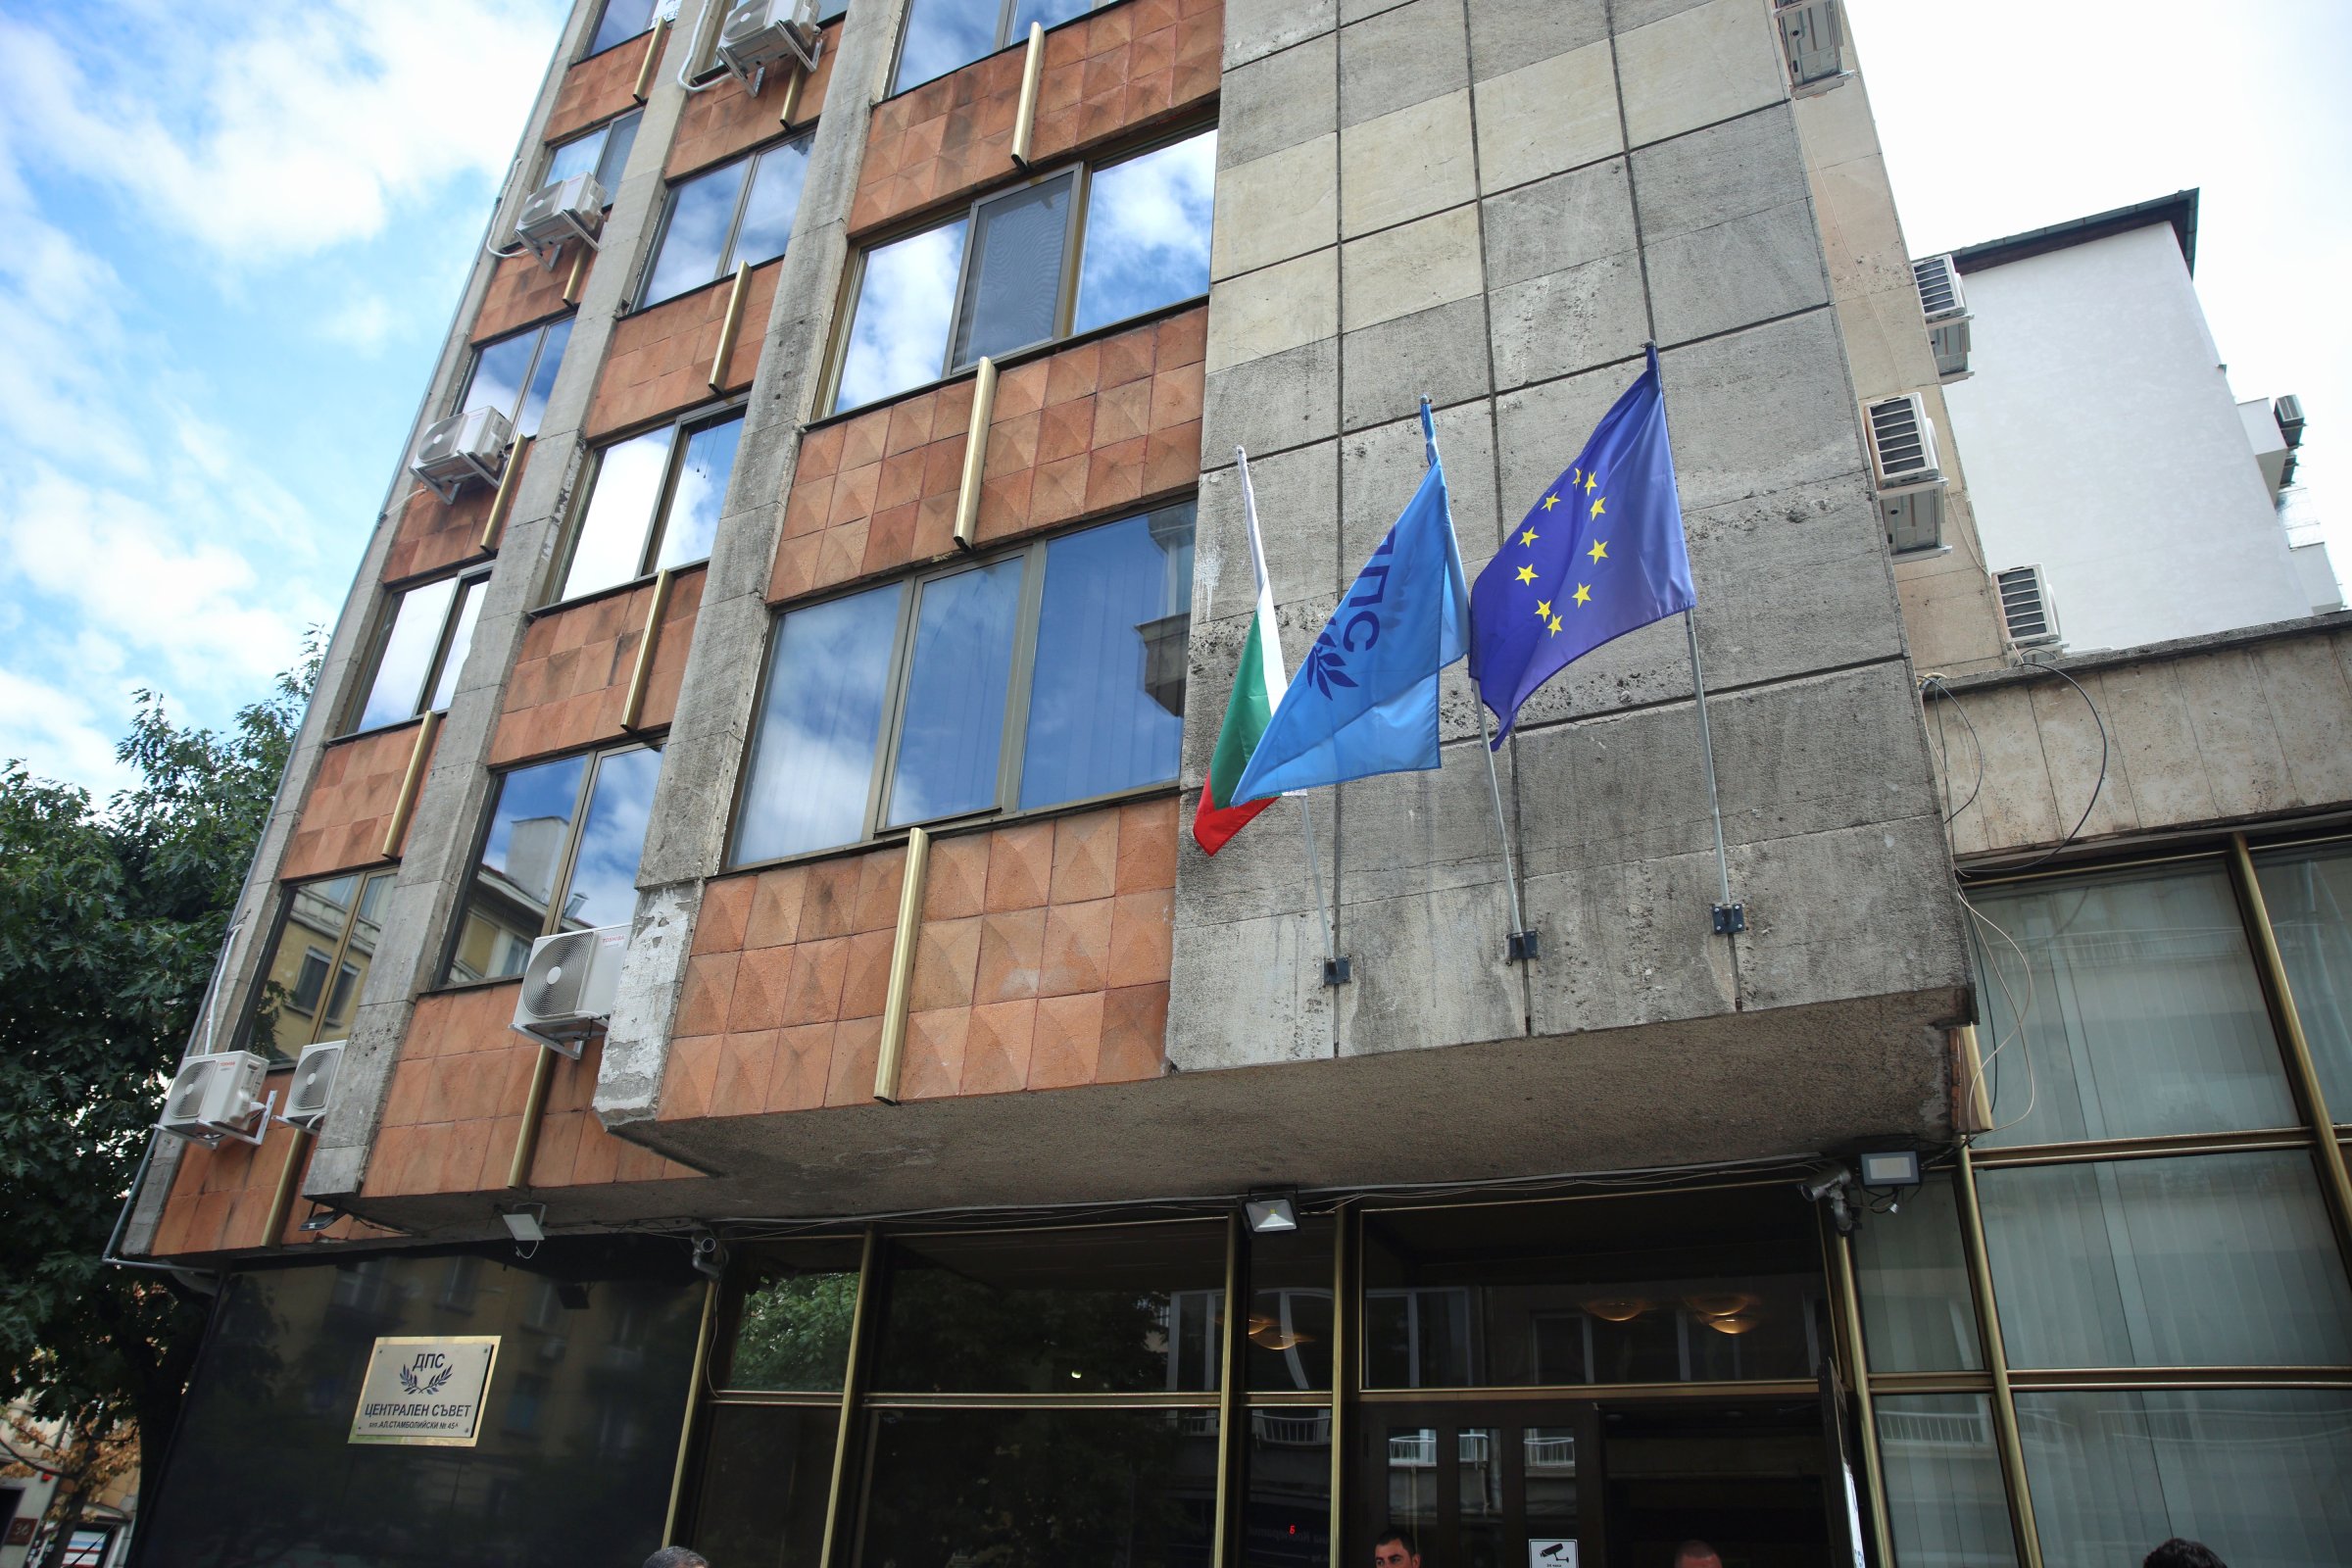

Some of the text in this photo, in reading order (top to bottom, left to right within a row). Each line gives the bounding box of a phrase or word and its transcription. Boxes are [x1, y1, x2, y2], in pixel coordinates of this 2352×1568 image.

[412, 1353, 446, 1372] ДПС
[365, 1403, 471, 1418] ЦЕНТРАЛЕН СЪВЕТ
